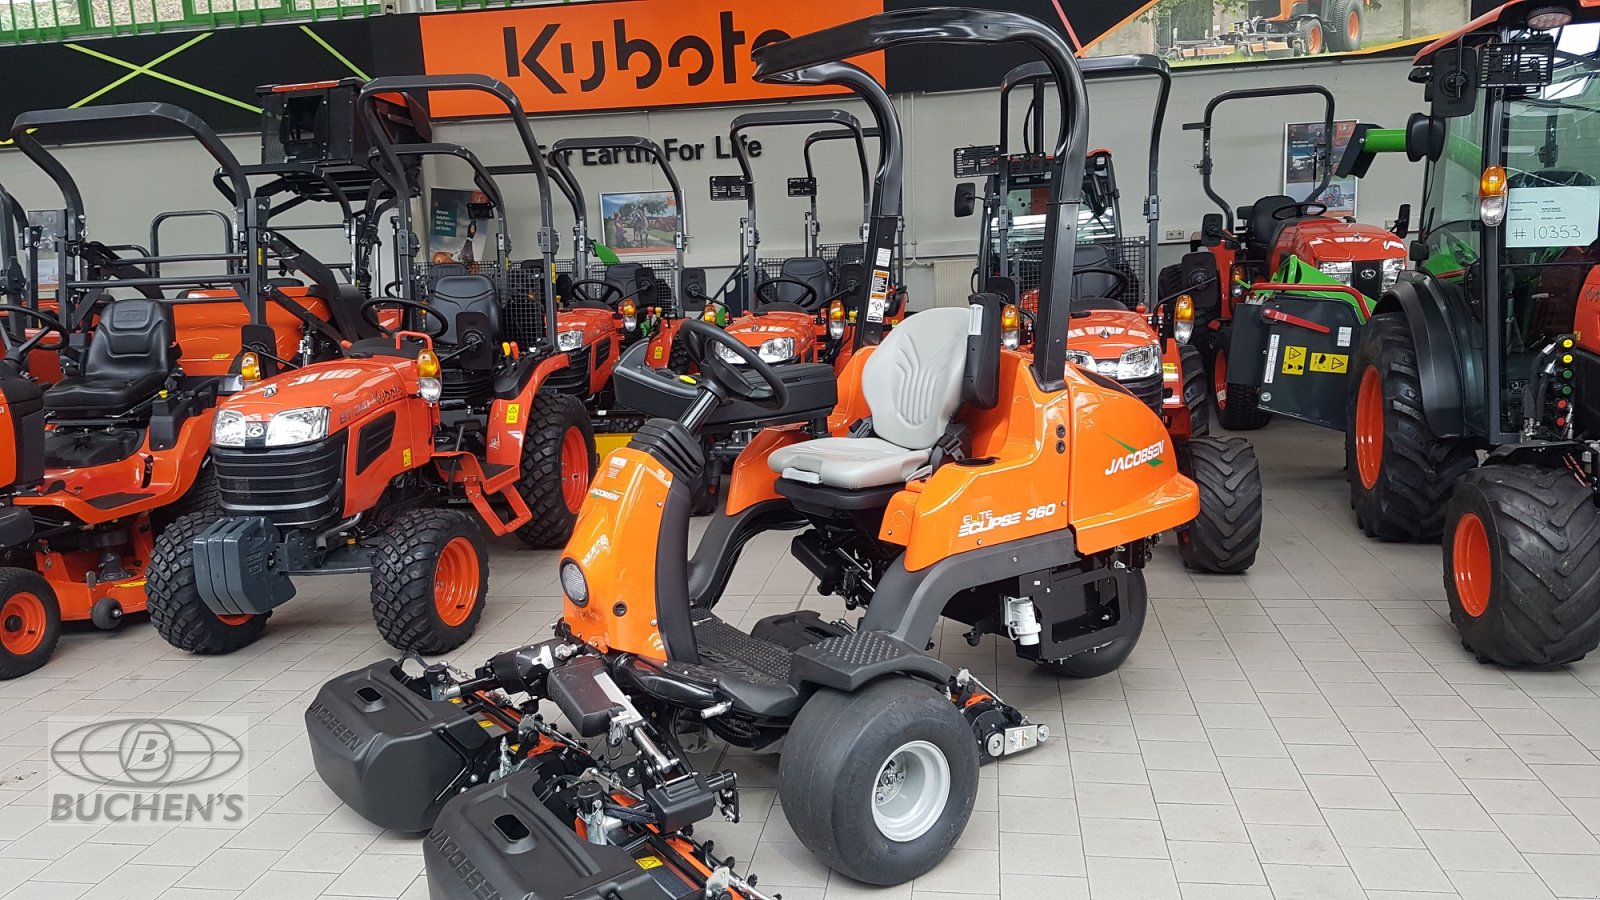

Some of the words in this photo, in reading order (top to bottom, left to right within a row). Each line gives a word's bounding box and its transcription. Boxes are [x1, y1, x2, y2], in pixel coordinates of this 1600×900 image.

[664, 138, 704, 161] For
[1533, 225, 1581, 240] 10353
[1104, 439, 1165, 476] JACOBSEN
[958, 512, 1022, 537] ECLIPSE
[1025, 503, 1057, 521] 360
